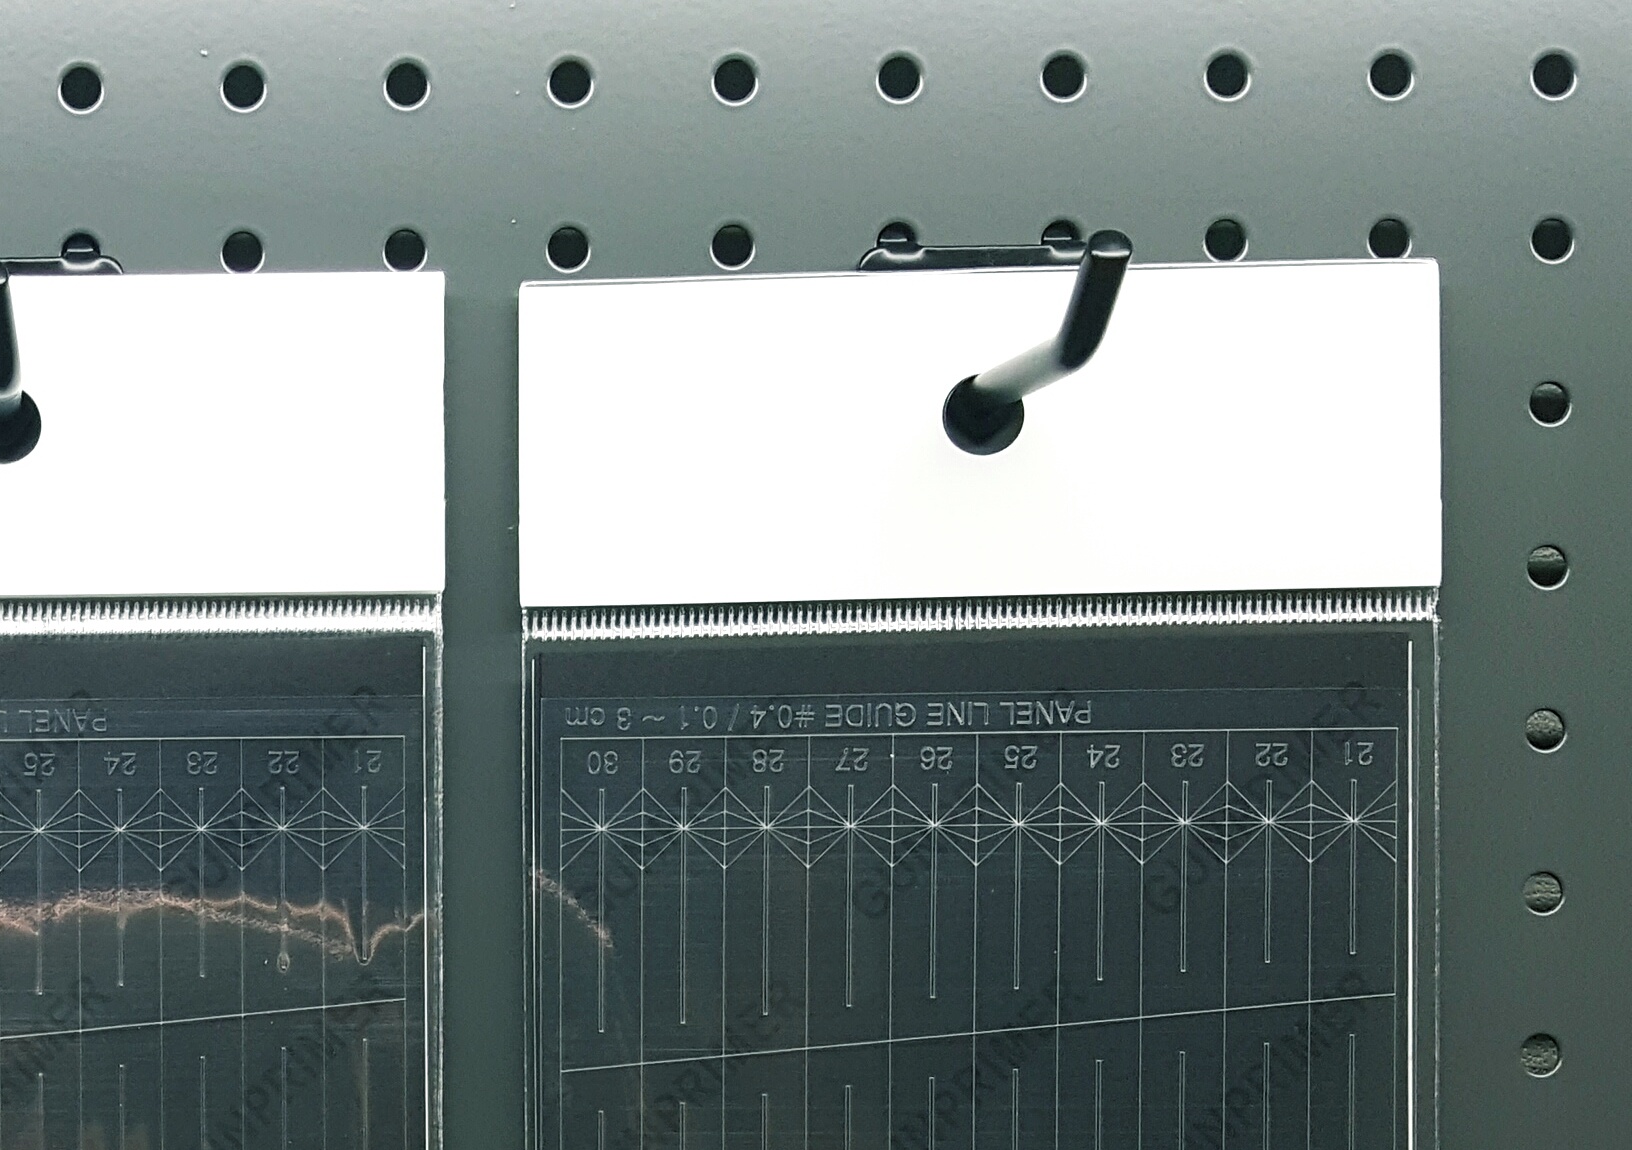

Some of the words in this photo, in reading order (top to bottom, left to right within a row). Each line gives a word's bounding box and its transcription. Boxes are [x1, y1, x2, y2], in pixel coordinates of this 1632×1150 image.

[18, 708, 107, 733] PANEL
[565, 707, 606, 726] cm
[680, 705, 718, 730] 0.1
[750, 704, 815, 729] #0.4
[825, 702, 916, 727] GUIDE
[926, 702, 988, 726] LINE
[1000, 700, 1092, 726] PANEL
[23, 753, 55, 776] 25
[104, 753, 136, 775] 24
[187, 751, 217, 774] 23
[268, 751, 299, 774] 22
[588, 751, 618, 774] 30
[669, 750, 701, 773] 29
[753, 749, 784, 772] 28
[835, 748, 869, 771] 27
[921, 746, 952, 770] 26
[1005, 746, 1037, 769] 25
[1087, 745, 1120, 768] 24
[1171, 744, 1204, 767] 23
[1256, 743, 1288, 766] 22
[1345, 742, 1373, 765] 21
